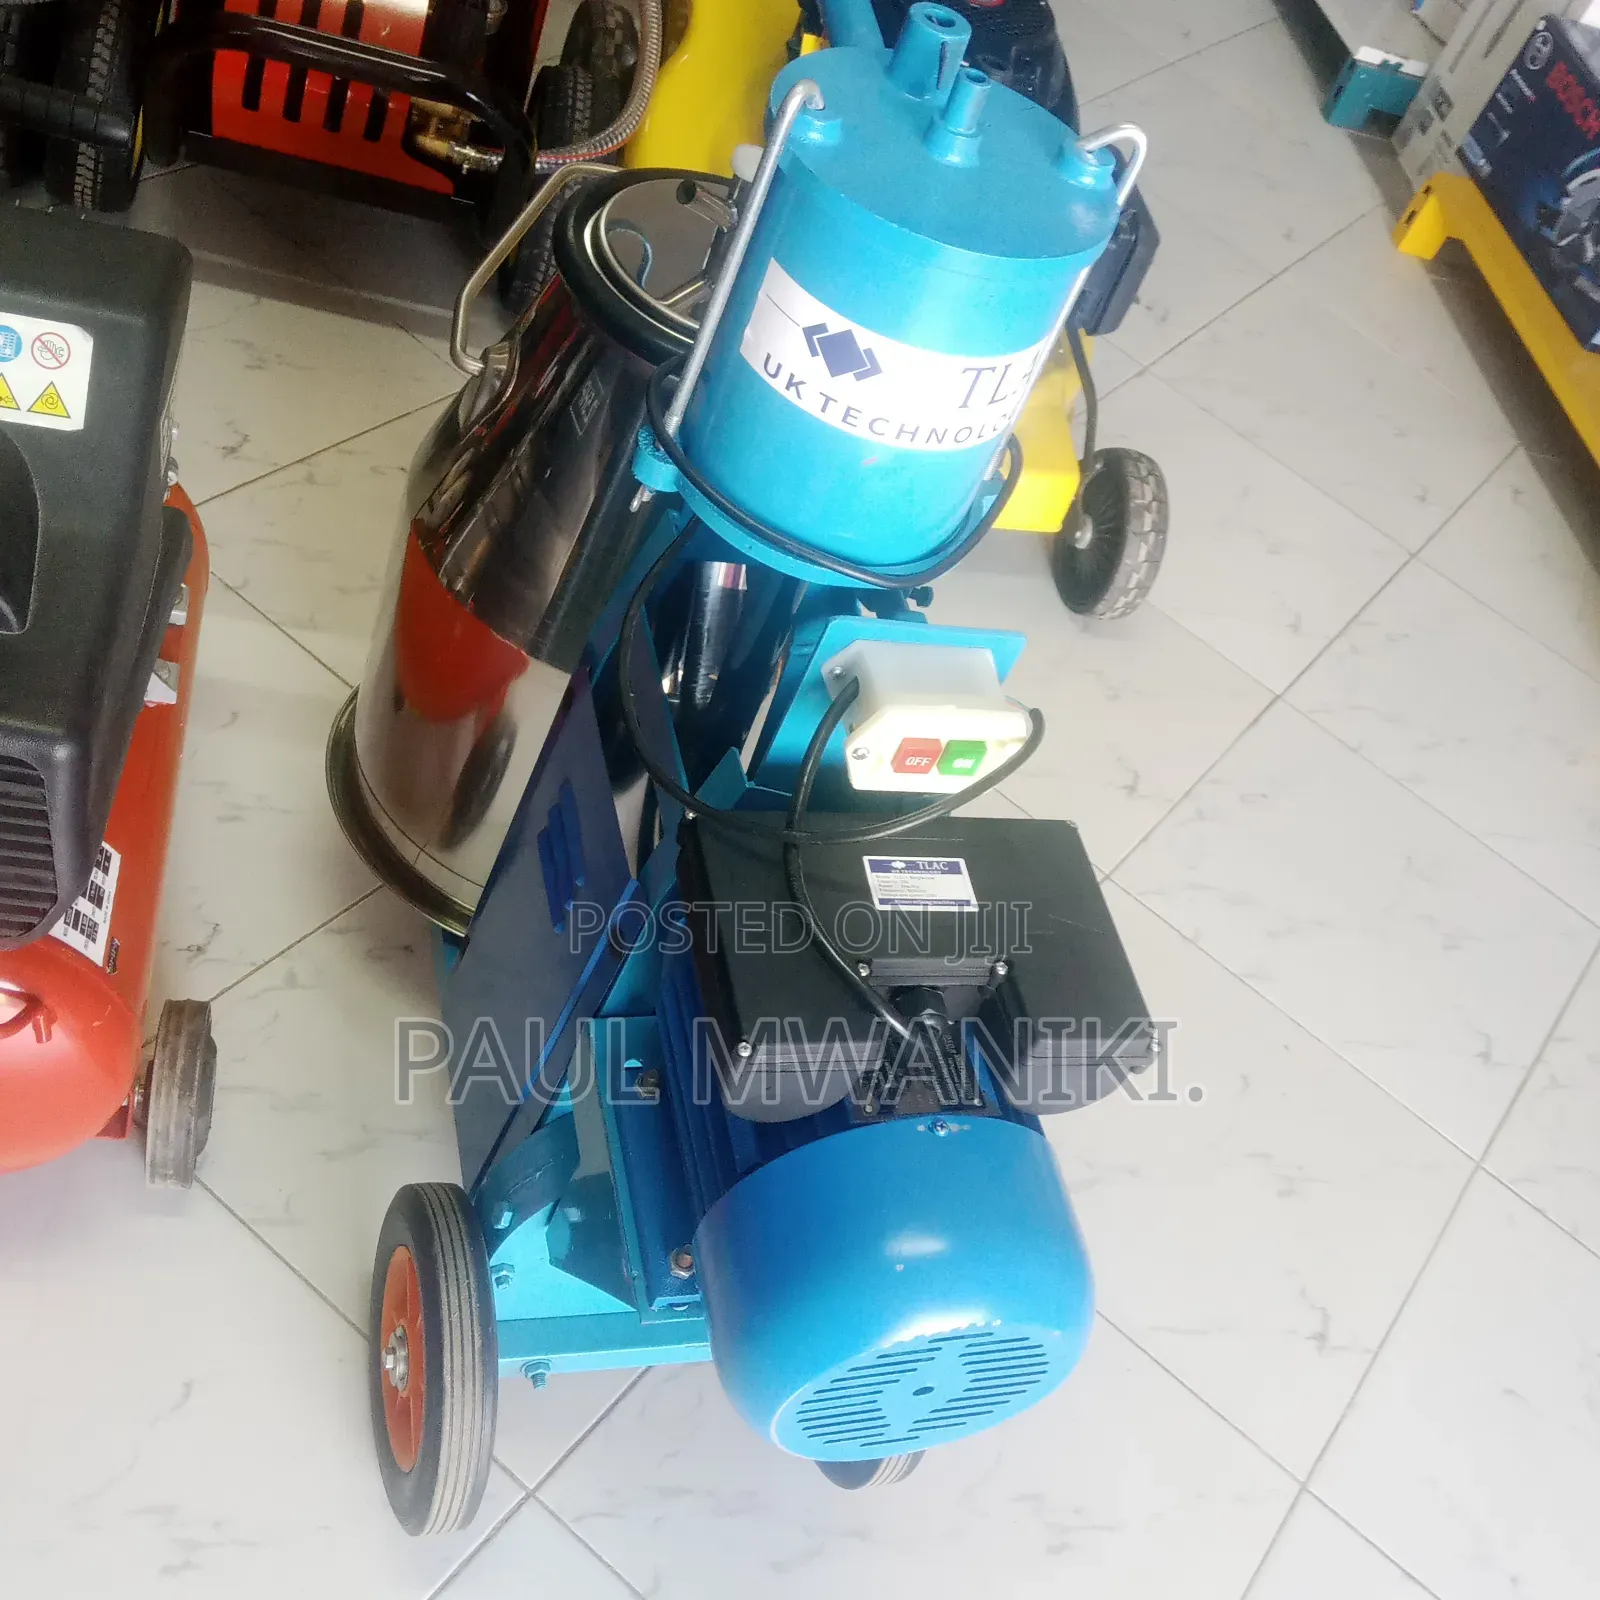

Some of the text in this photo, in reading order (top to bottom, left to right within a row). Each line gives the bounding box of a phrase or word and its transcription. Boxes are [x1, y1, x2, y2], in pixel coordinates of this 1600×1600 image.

[762, 351, 807, 400] UK
[905, 756, 932, 767] OFF
[915, 861, 949, 871] TLAC
